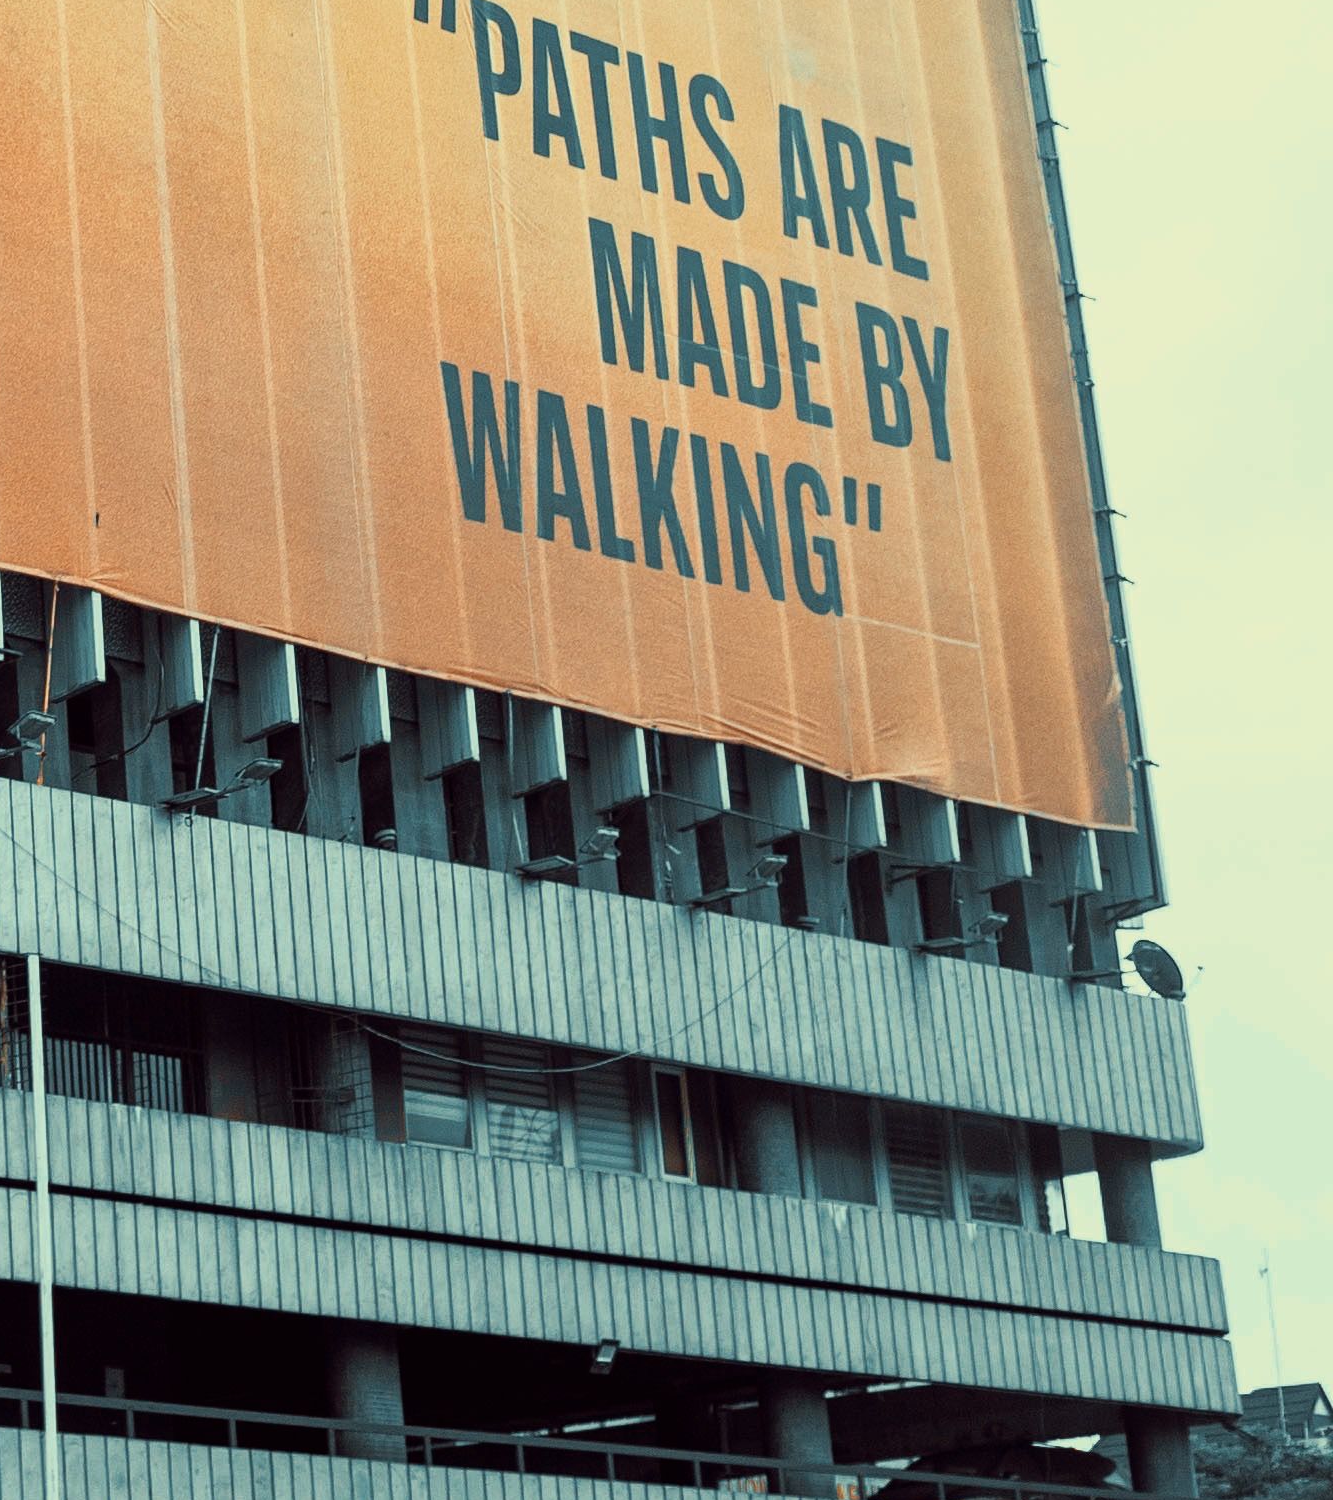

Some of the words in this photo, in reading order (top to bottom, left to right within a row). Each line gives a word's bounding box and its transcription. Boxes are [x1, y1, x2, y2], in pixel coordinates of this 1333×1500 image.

[778, 103, 929, 282] ARE
[587, 216, 834, 430] MADE
[855, 301, 952, 463] BY
